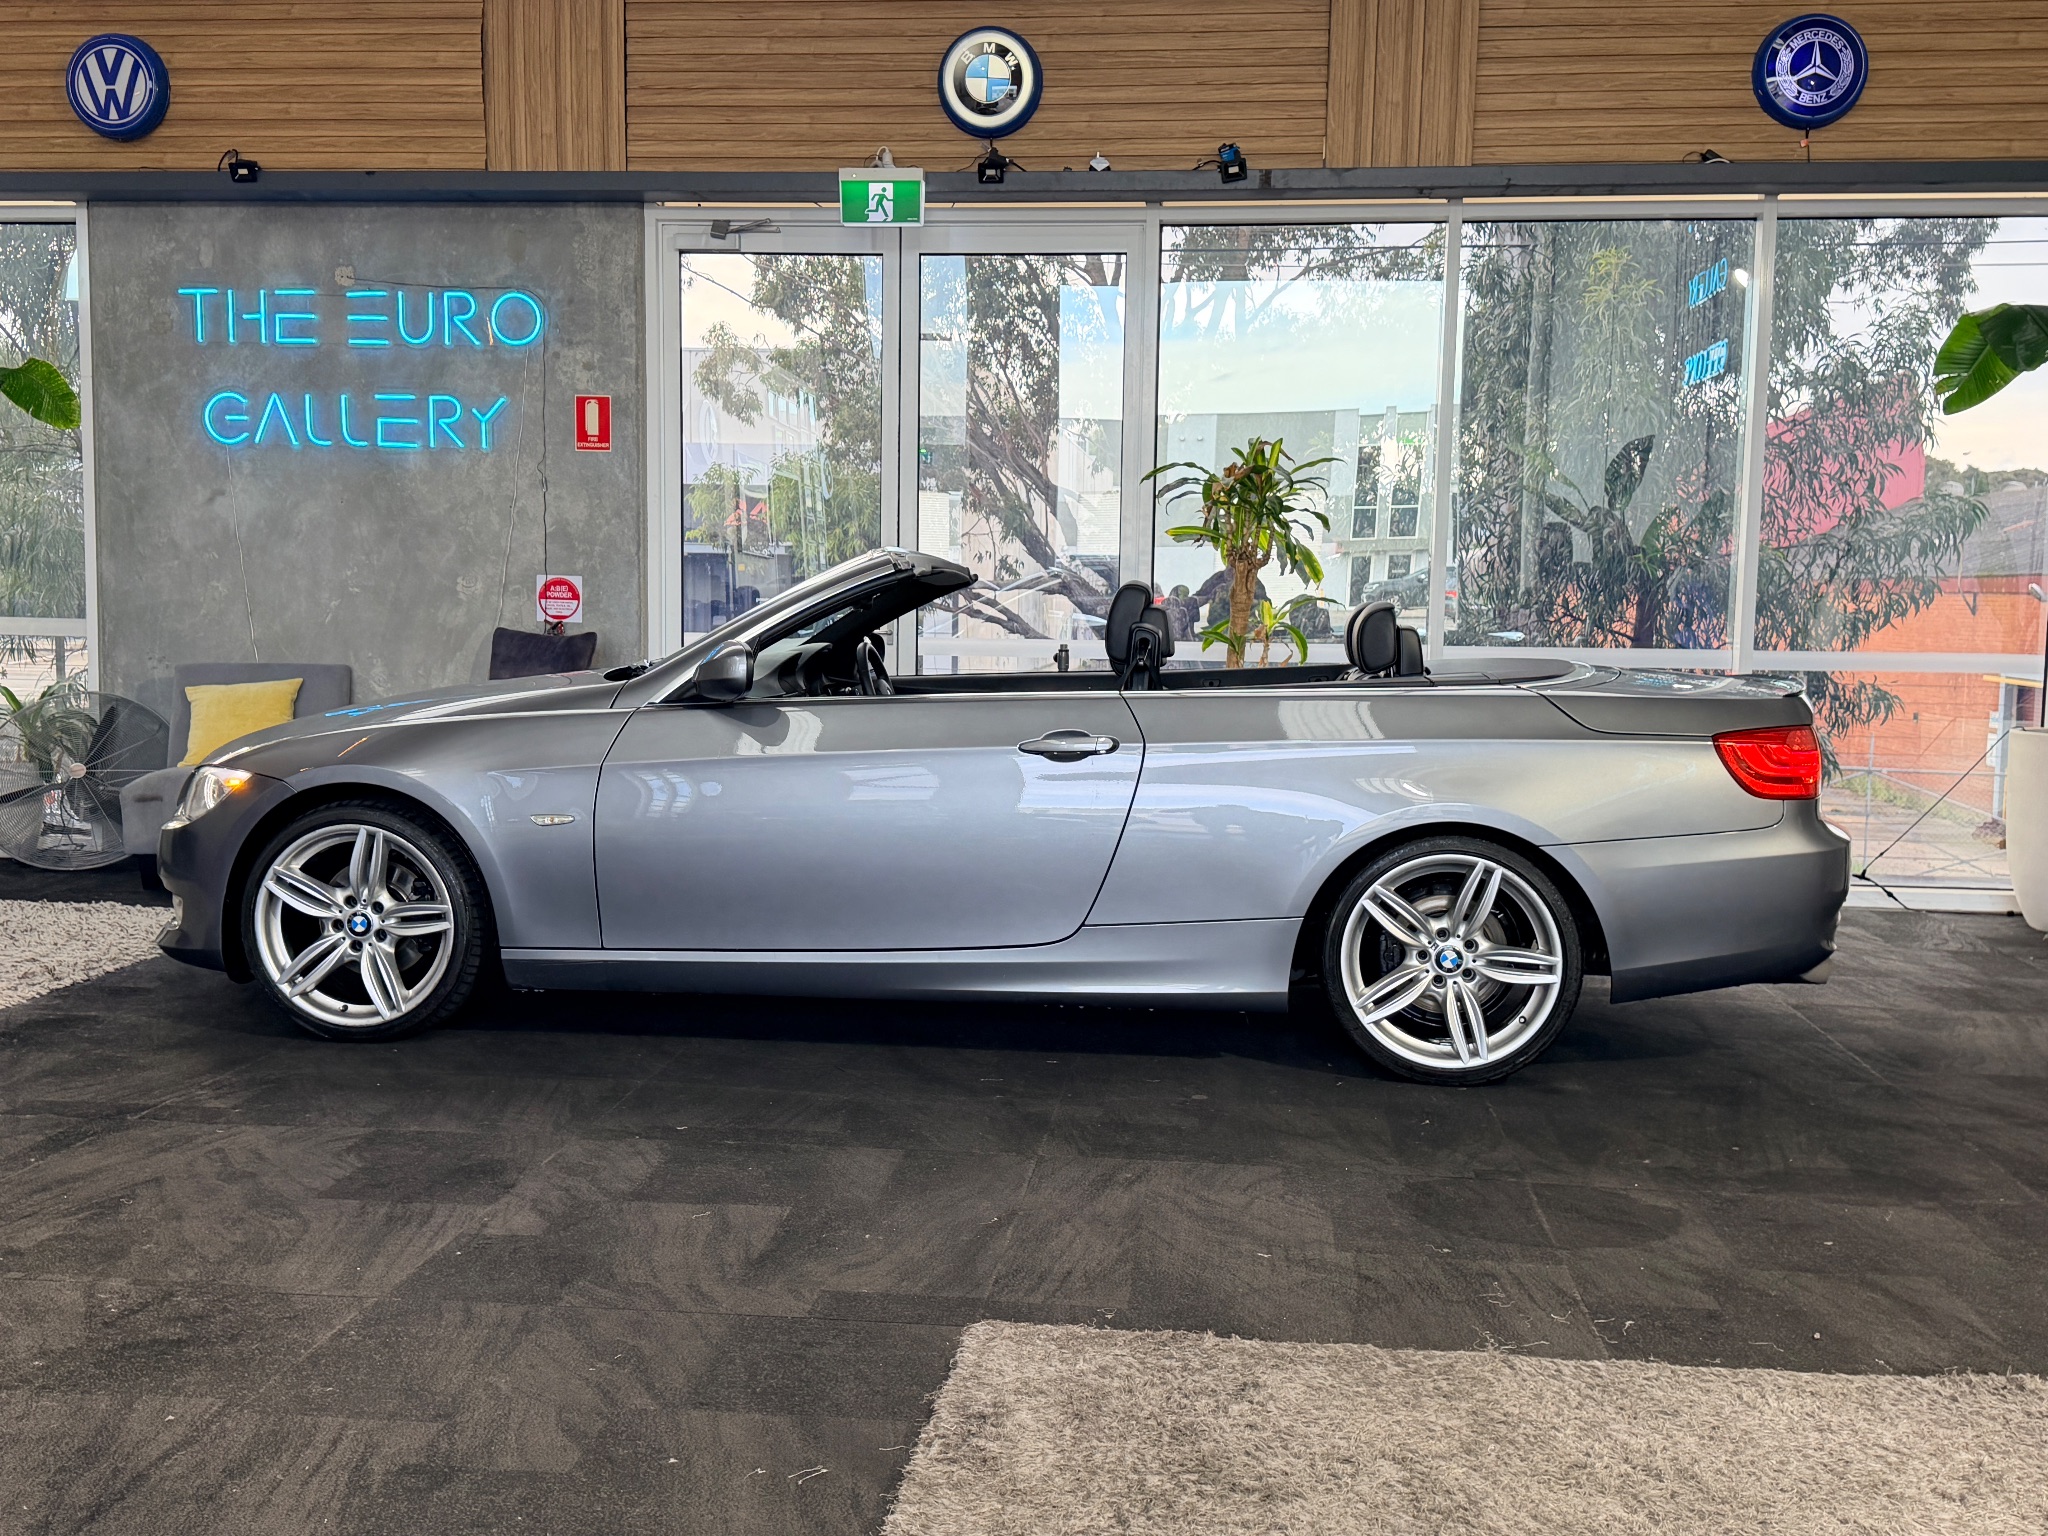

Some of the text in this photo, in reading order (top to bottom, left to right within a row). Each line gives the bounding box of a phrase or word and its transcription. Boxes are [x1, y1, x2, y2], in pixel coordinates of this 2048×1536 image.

[1789, 30, 1844, 50] MERCEDES
[960, 42, 1018, 66] BMW
[1798, 93, 1828, 103] BENZ
[178, 287, 543, 347] THE EURO
[203, 391, 507, 449] GALLERY
